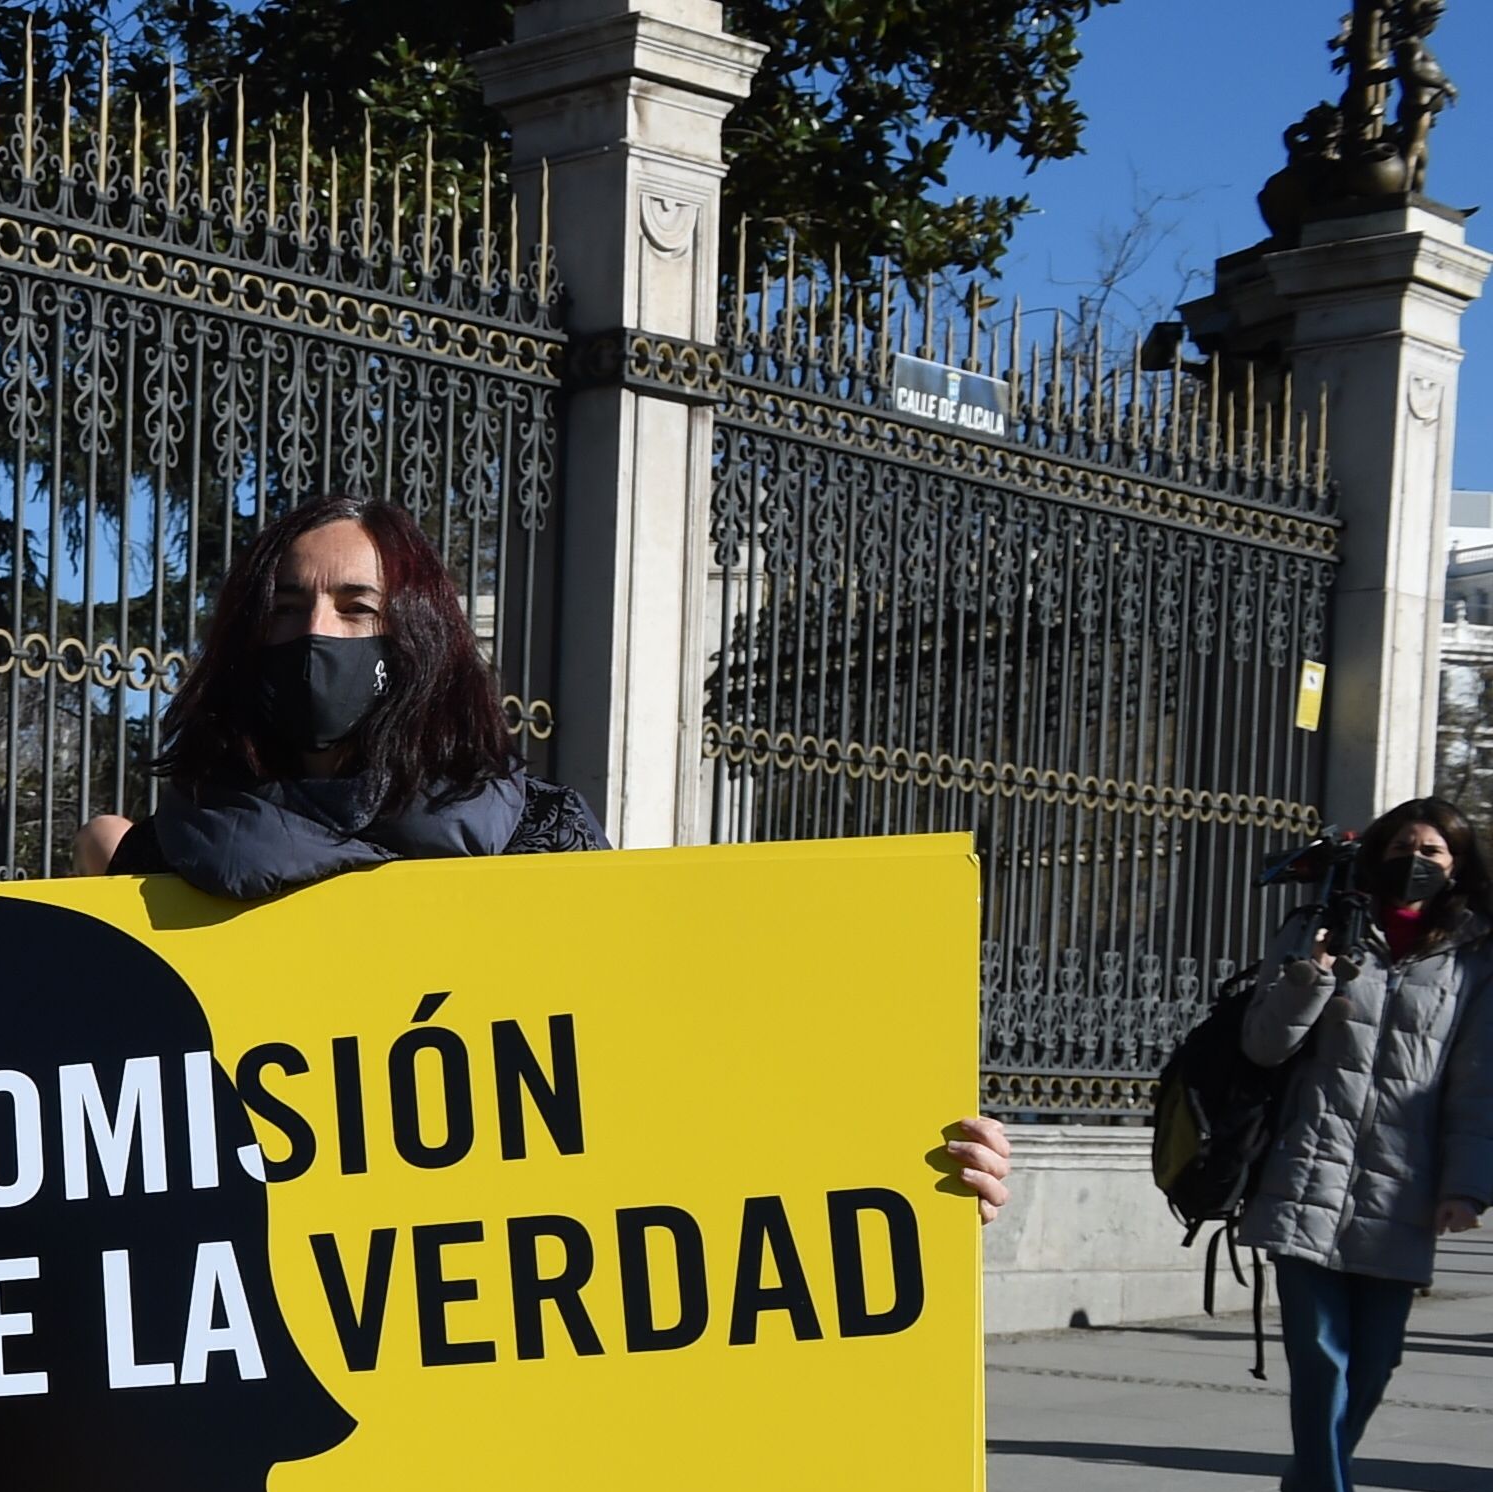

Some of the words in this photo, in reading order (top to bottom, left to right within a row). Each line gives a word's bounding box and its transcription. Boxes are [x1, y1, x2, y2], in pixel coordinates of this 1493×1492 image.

[896, 386, 938, 419] CALLE
[938, 397, 958, 424] DE
[102, 1241, 268, 1389] LA
[309, 1187, 926, 1373] VERDAD
